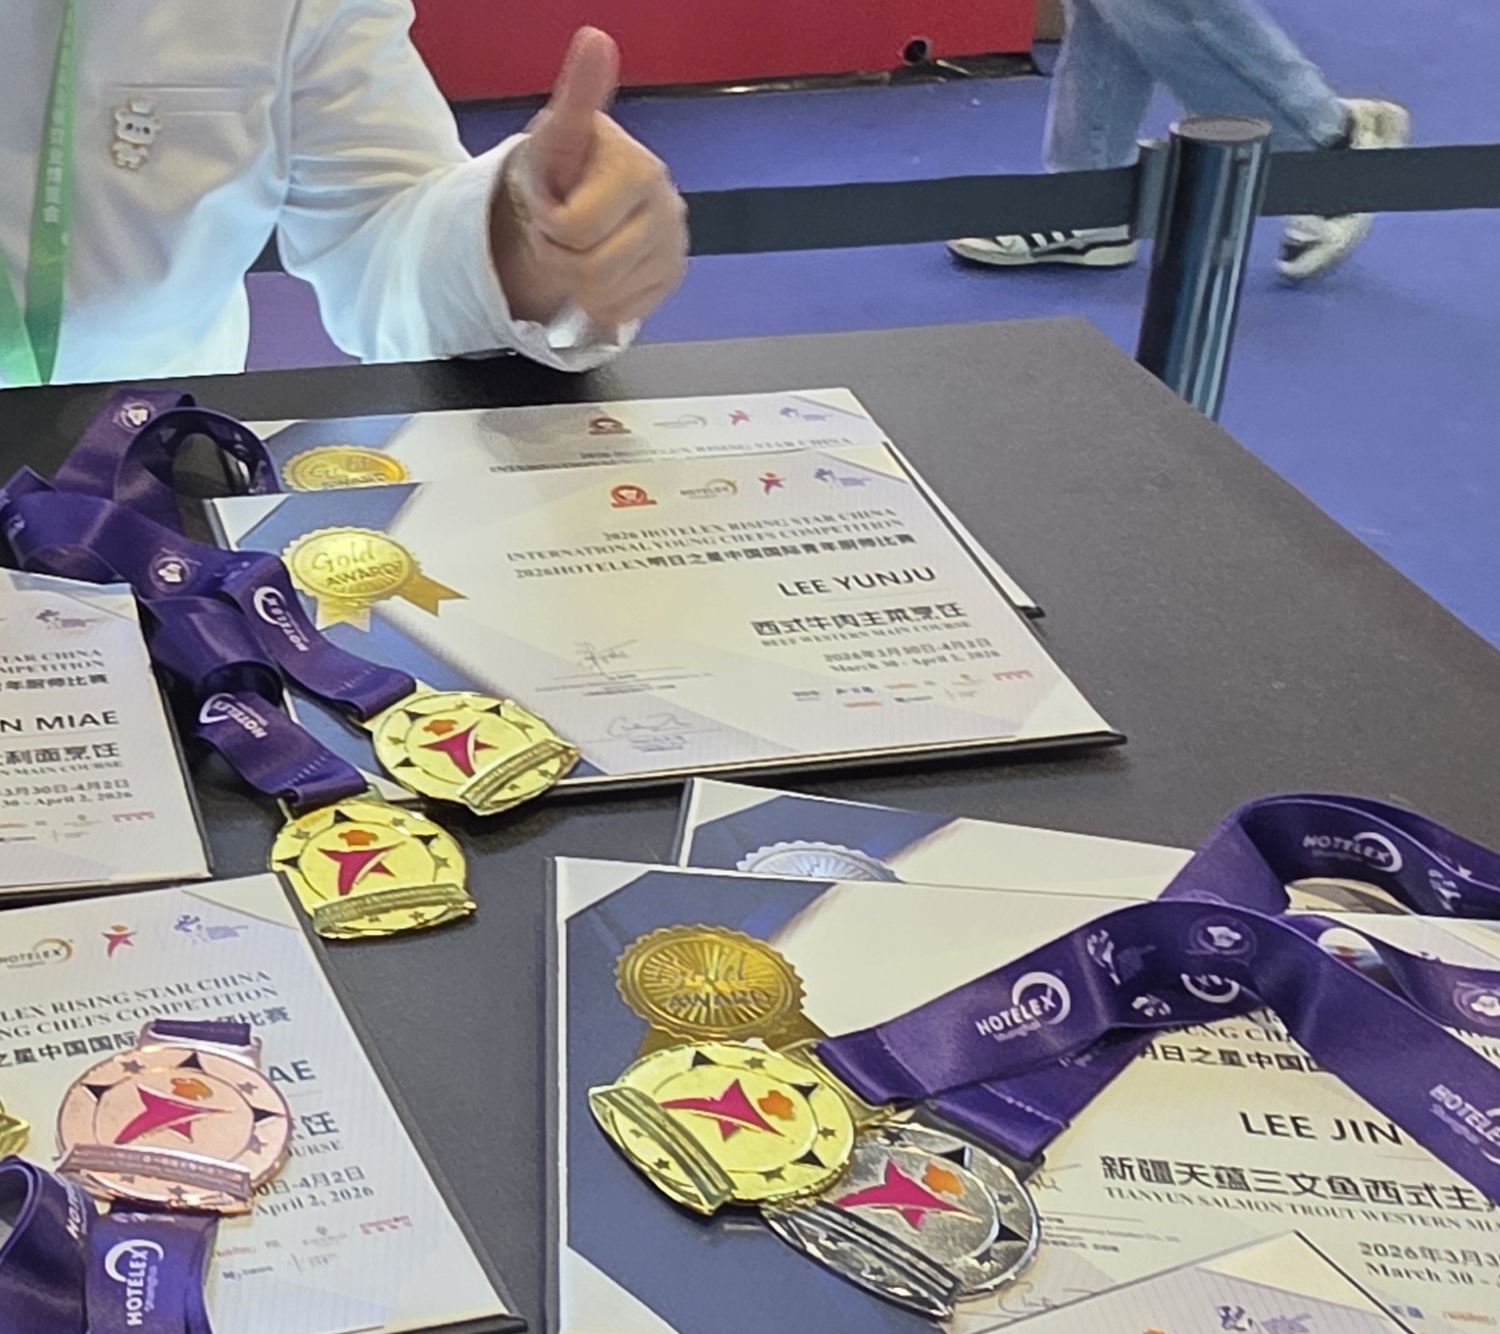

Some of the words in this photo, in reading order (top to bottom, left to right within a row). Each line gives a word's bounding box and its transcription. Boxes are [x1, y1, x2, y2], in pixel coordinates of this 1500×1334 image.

[777, 578, 832, 597] LEE
[832, 566, 937, 593] YUNJU
[36, 709, 120, 731] MIAE
[1303, 834, 1393, 865] HOTELEX
[50, 990, 131, 1015] RISING
[133, 979, 194, 1001] STAR
[195, 969, 273, 994] CHINA
[36, 1012, 112, 1036] CHEFS
[116, 984, 280, 1025] COMPETITION
[975, 988, 1057, 1038] HOTELEX
[1239, 1111, 1318, 1140] LEE
[1101, 1154, 1500, 1214] 新疆天蕴三文鱼西式主
[1103, 1185, 1194, 1208] TIANYUN
[1196, 1192, 1285, 1215] SALMON
[255, 1195, 305, 1218] April
[330, 1185, 376, 1204] 2026
[127, 1246, 150, 1327] HOTELEX
[1364, 1261, 1443, 1284] March
